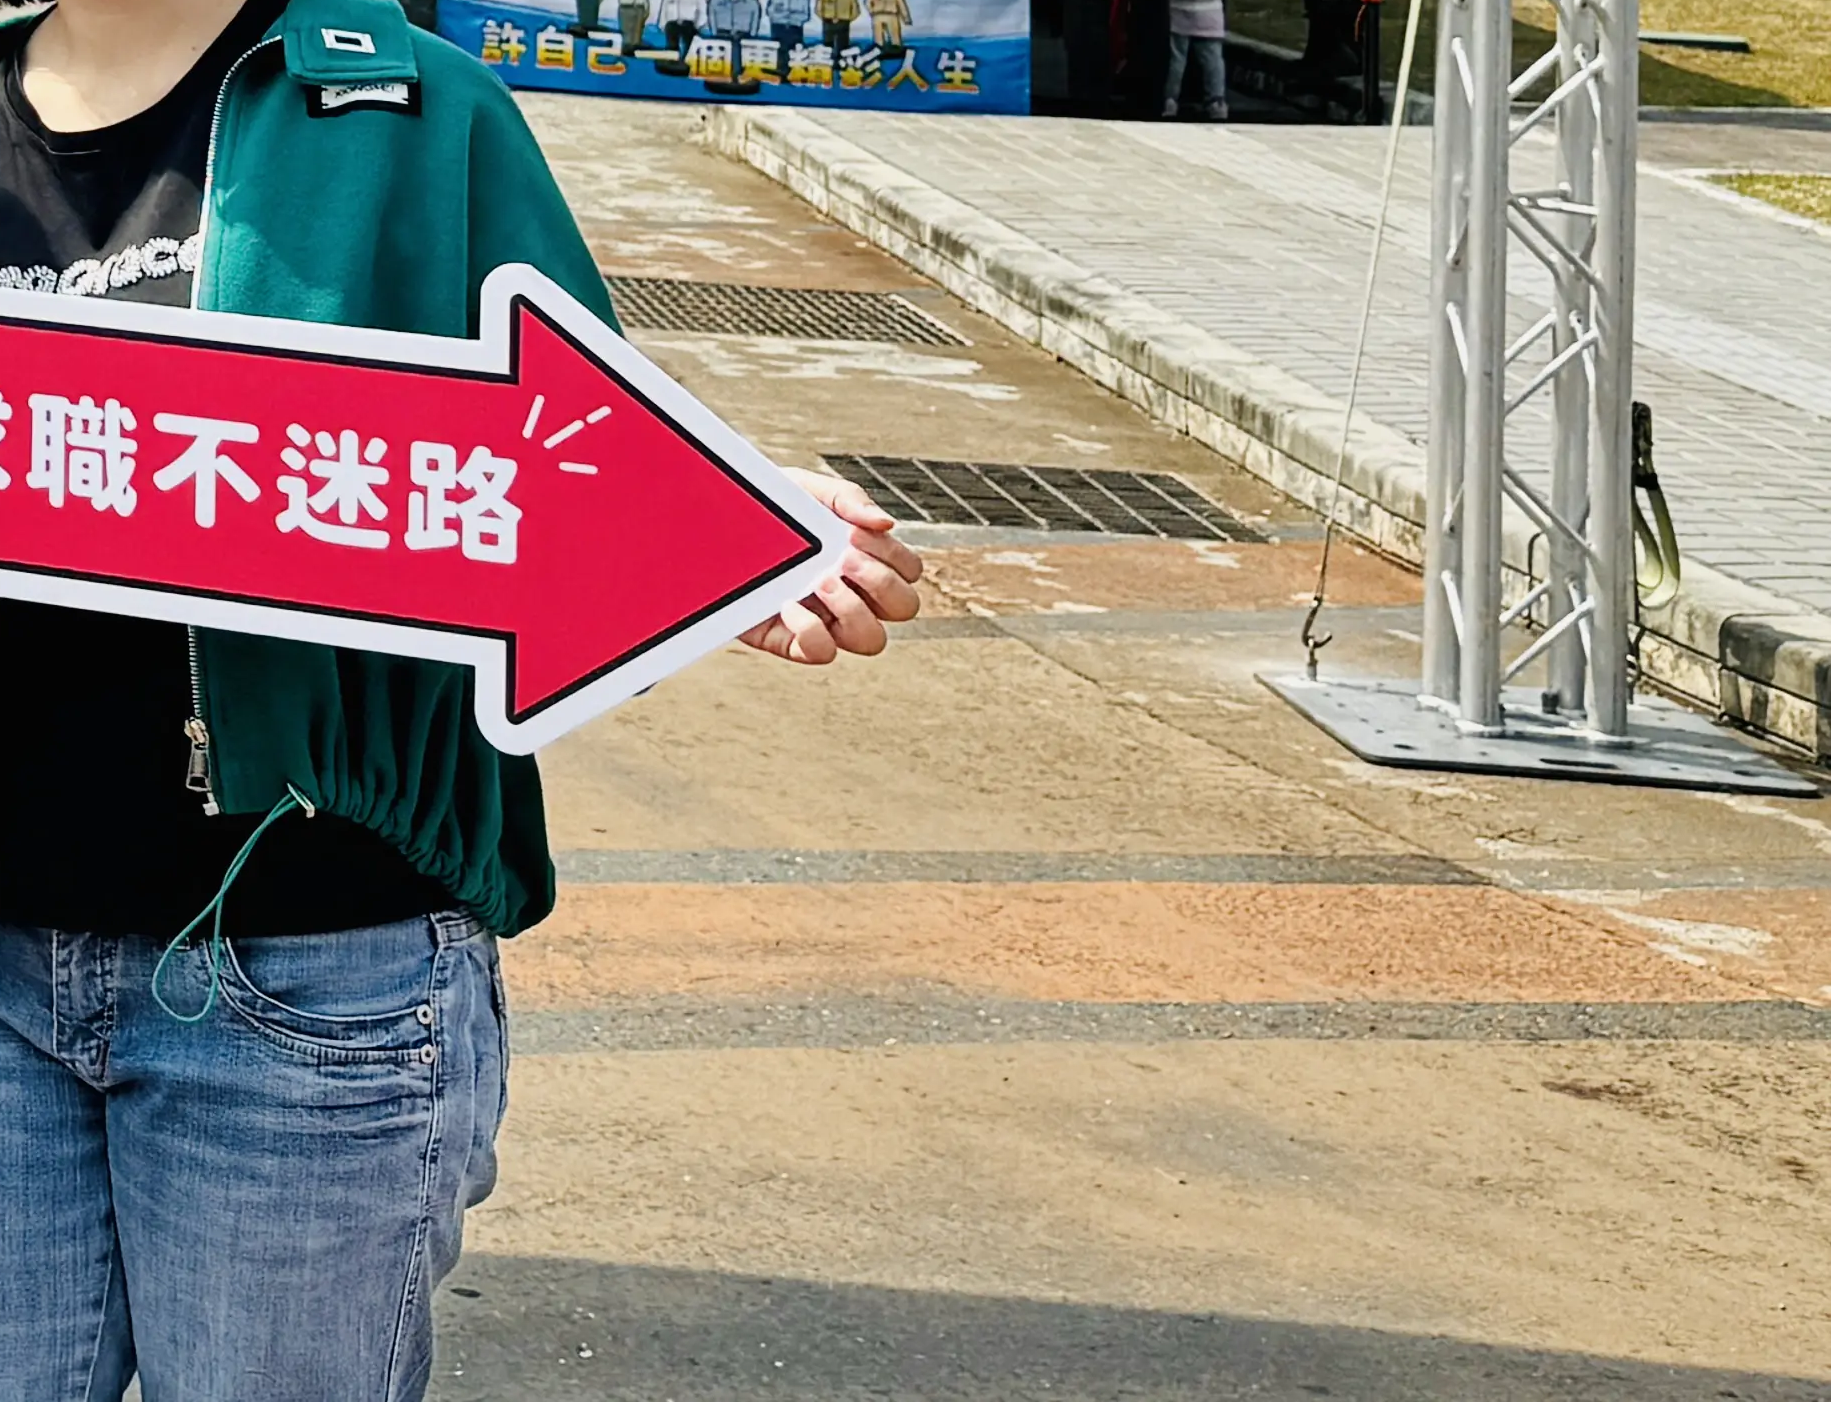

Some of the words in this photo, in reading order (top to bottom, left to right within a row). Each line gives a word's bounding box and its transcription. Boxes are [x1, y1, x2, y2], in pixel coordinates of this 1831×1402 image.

[481, 19, 980, 94] 許自己一個更精彩人生
